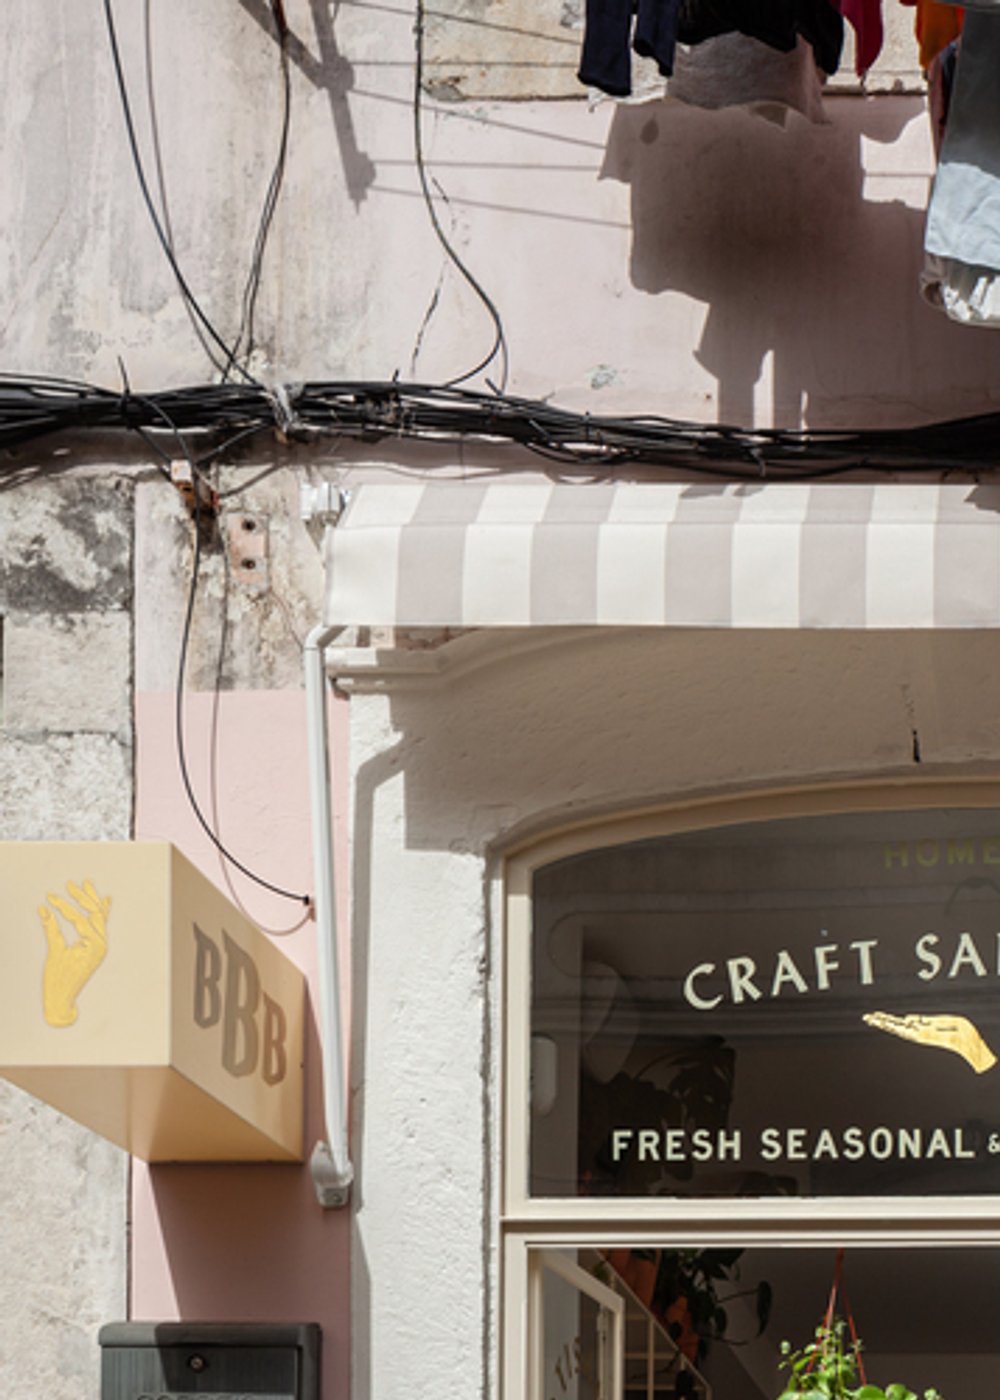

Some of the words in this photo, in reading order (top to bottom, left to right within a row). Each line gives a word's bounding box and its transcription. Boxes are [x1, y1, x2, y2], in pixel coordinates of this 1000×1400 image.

[192, 921, 288, 1087] BBB
[684, 940, 878, 1009] CRAFT
[612, 1129, 741, 1161] FRESH
[760, 1127, 976, 1160] SEASONAL
